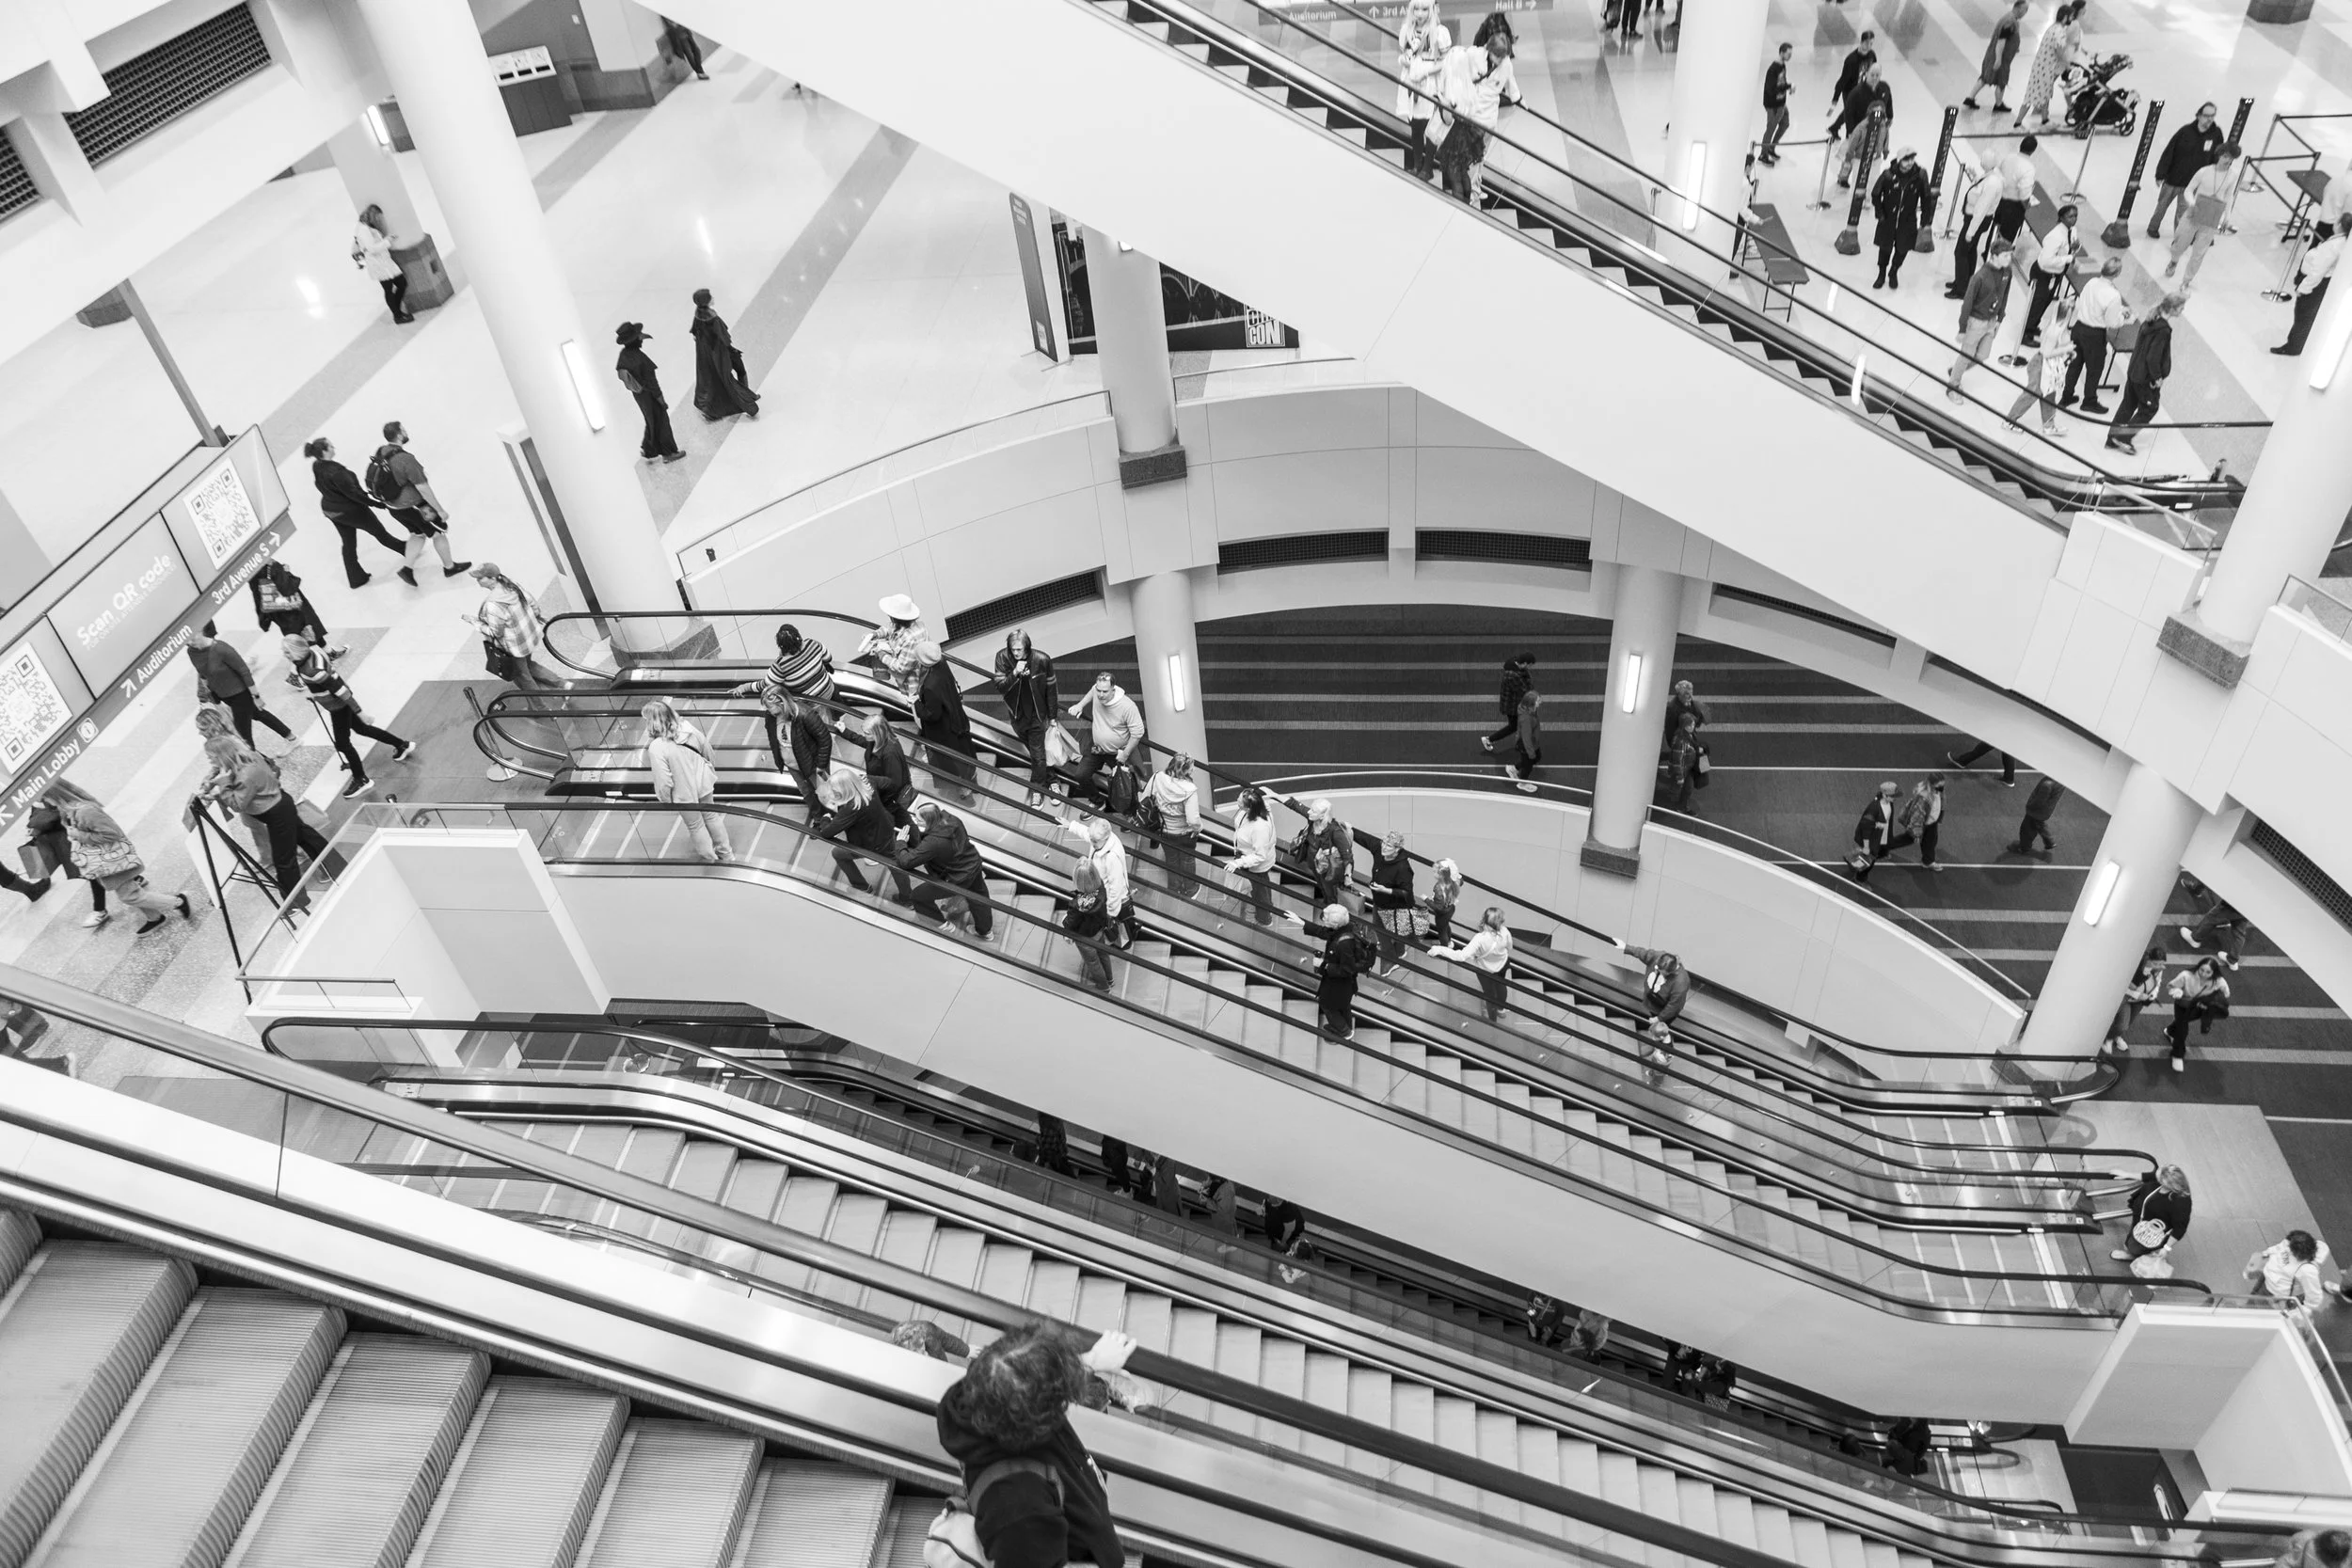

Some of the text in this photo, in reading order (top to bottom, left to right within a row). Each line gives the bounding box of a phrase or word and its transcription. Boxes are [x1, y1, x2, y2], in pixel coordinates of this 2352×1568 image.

[1382, 6, 1398, 17] 3rd
[1248, 319, 1280, 345] CON
[76, 610, 115, 645] Scan
[113, 582, 139, 610] QR
[138, 555, 171, 589] code
[211, 542, 270, 605] 3rd Avenue S
[136, 625, 193, 684] Auditorium
[11, 738, 81, 809] Main Lobby
